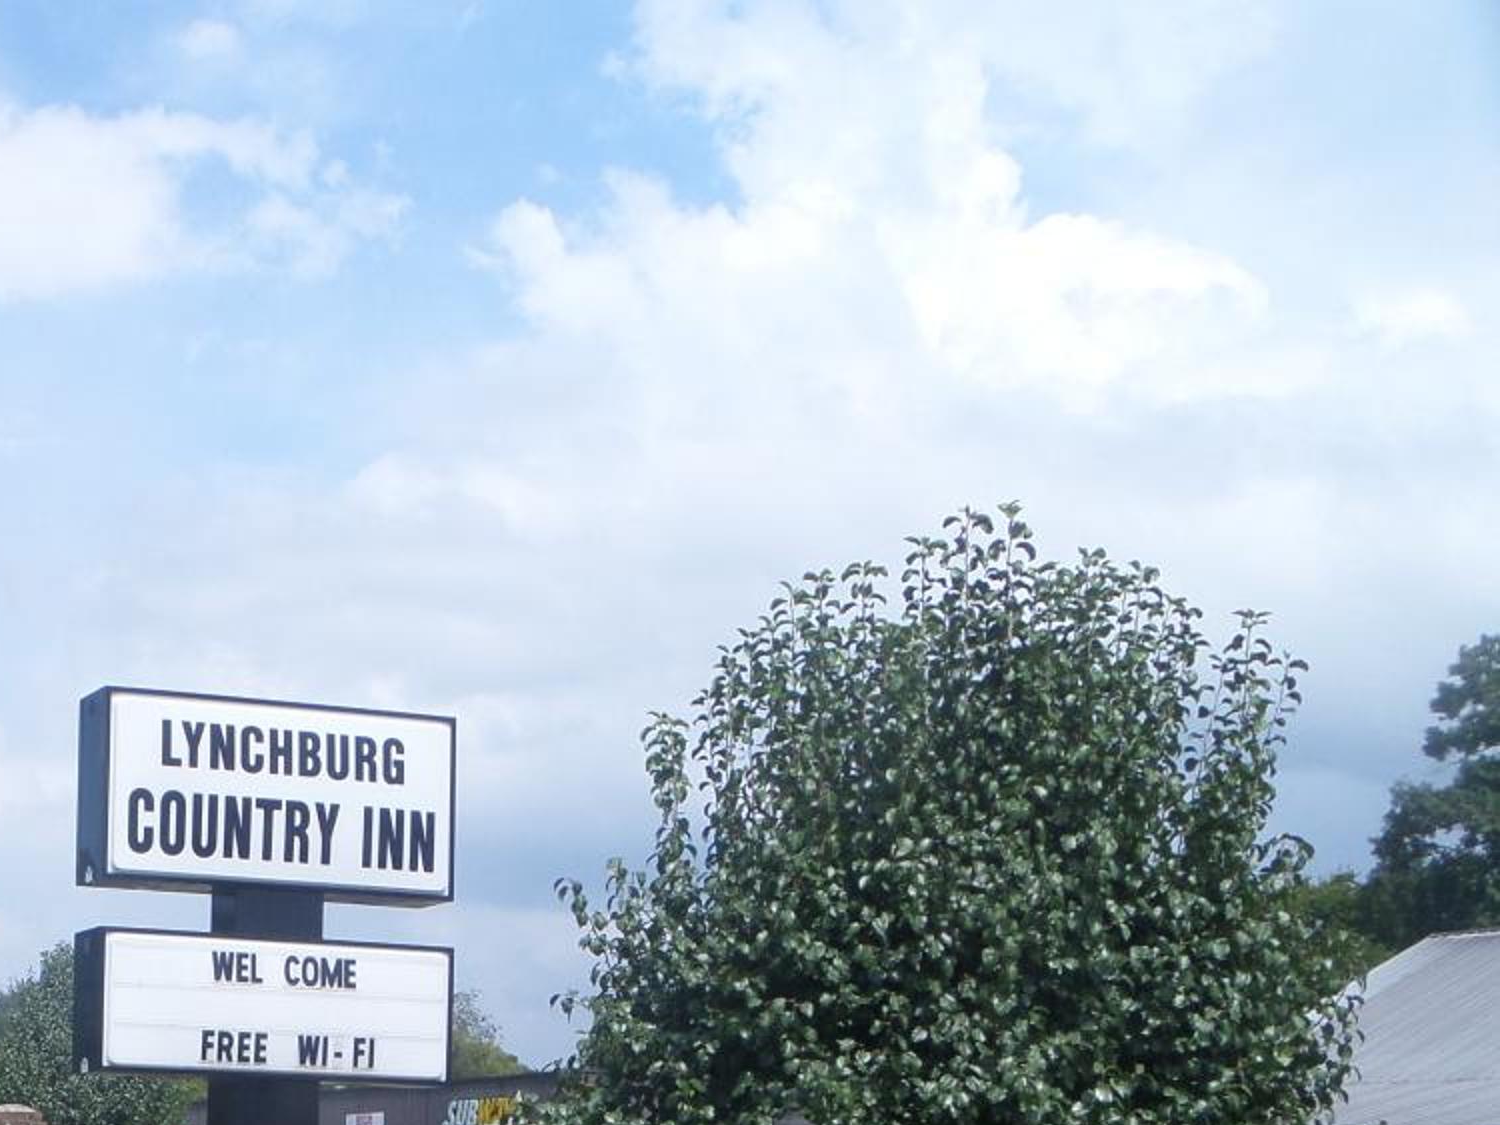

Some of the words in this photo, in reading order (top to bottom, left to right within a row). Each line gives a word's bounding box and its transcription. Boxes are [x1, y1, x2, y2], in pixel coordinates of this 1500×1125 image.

[161, 719, 405, 785] LYNCHBURG
[127, 787, 340, 865] COUNTRY
[361, 806, 436, 873] INN
[201, 1030, 268, 1064] FREE
